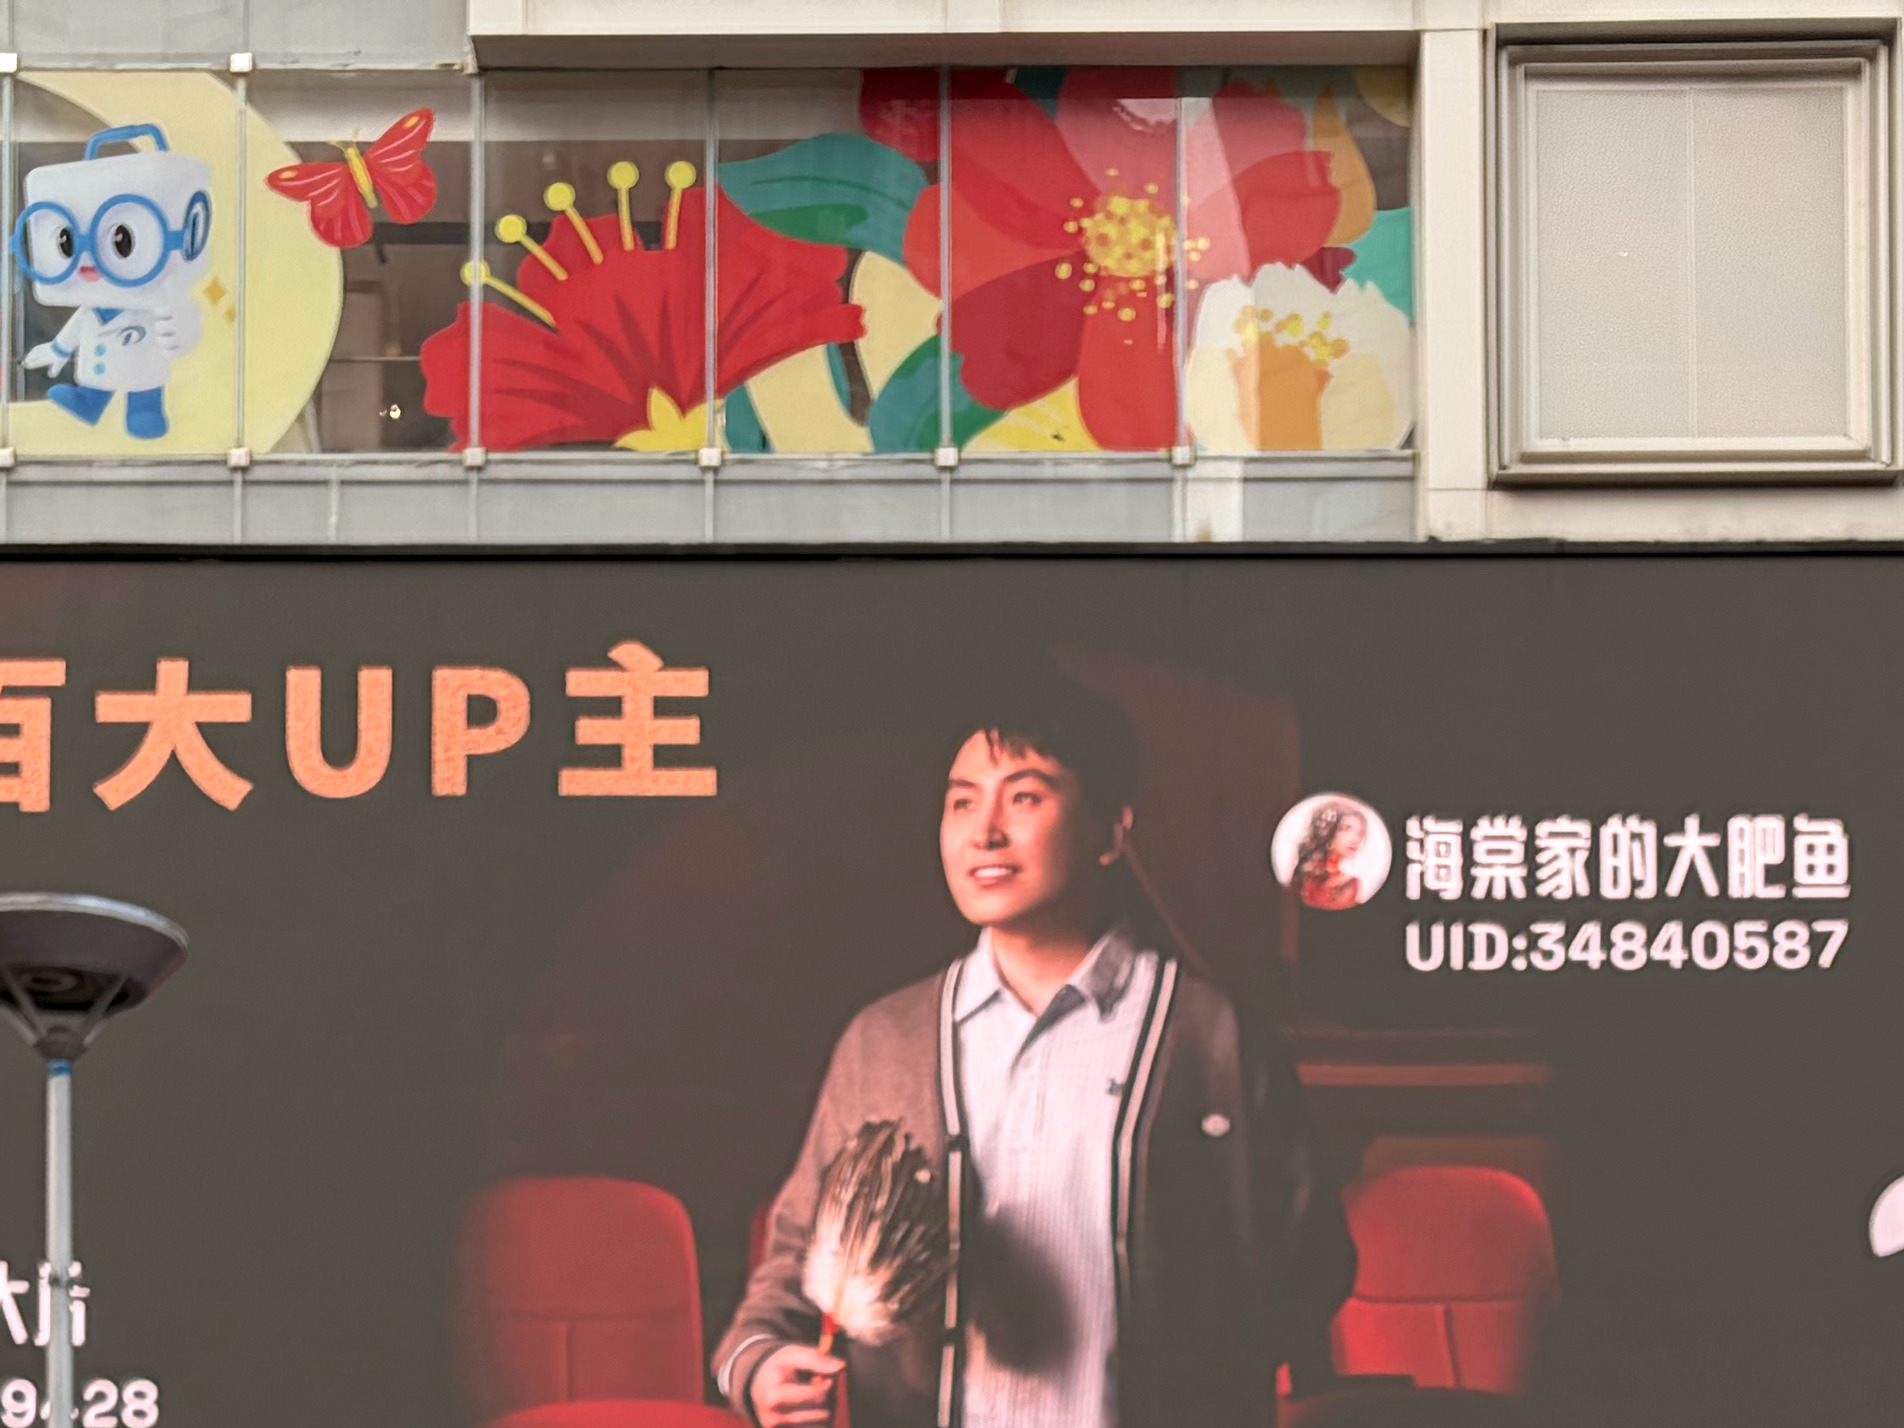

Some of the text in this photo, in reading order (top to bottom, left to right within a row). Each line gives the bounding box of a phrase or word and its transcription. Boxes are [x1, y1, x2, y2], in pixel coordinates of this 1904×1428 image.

[1405, 813, 1852, 900] 海棠家的大肥鱼
[1405, 919, 1850, 971] UID:34840587
